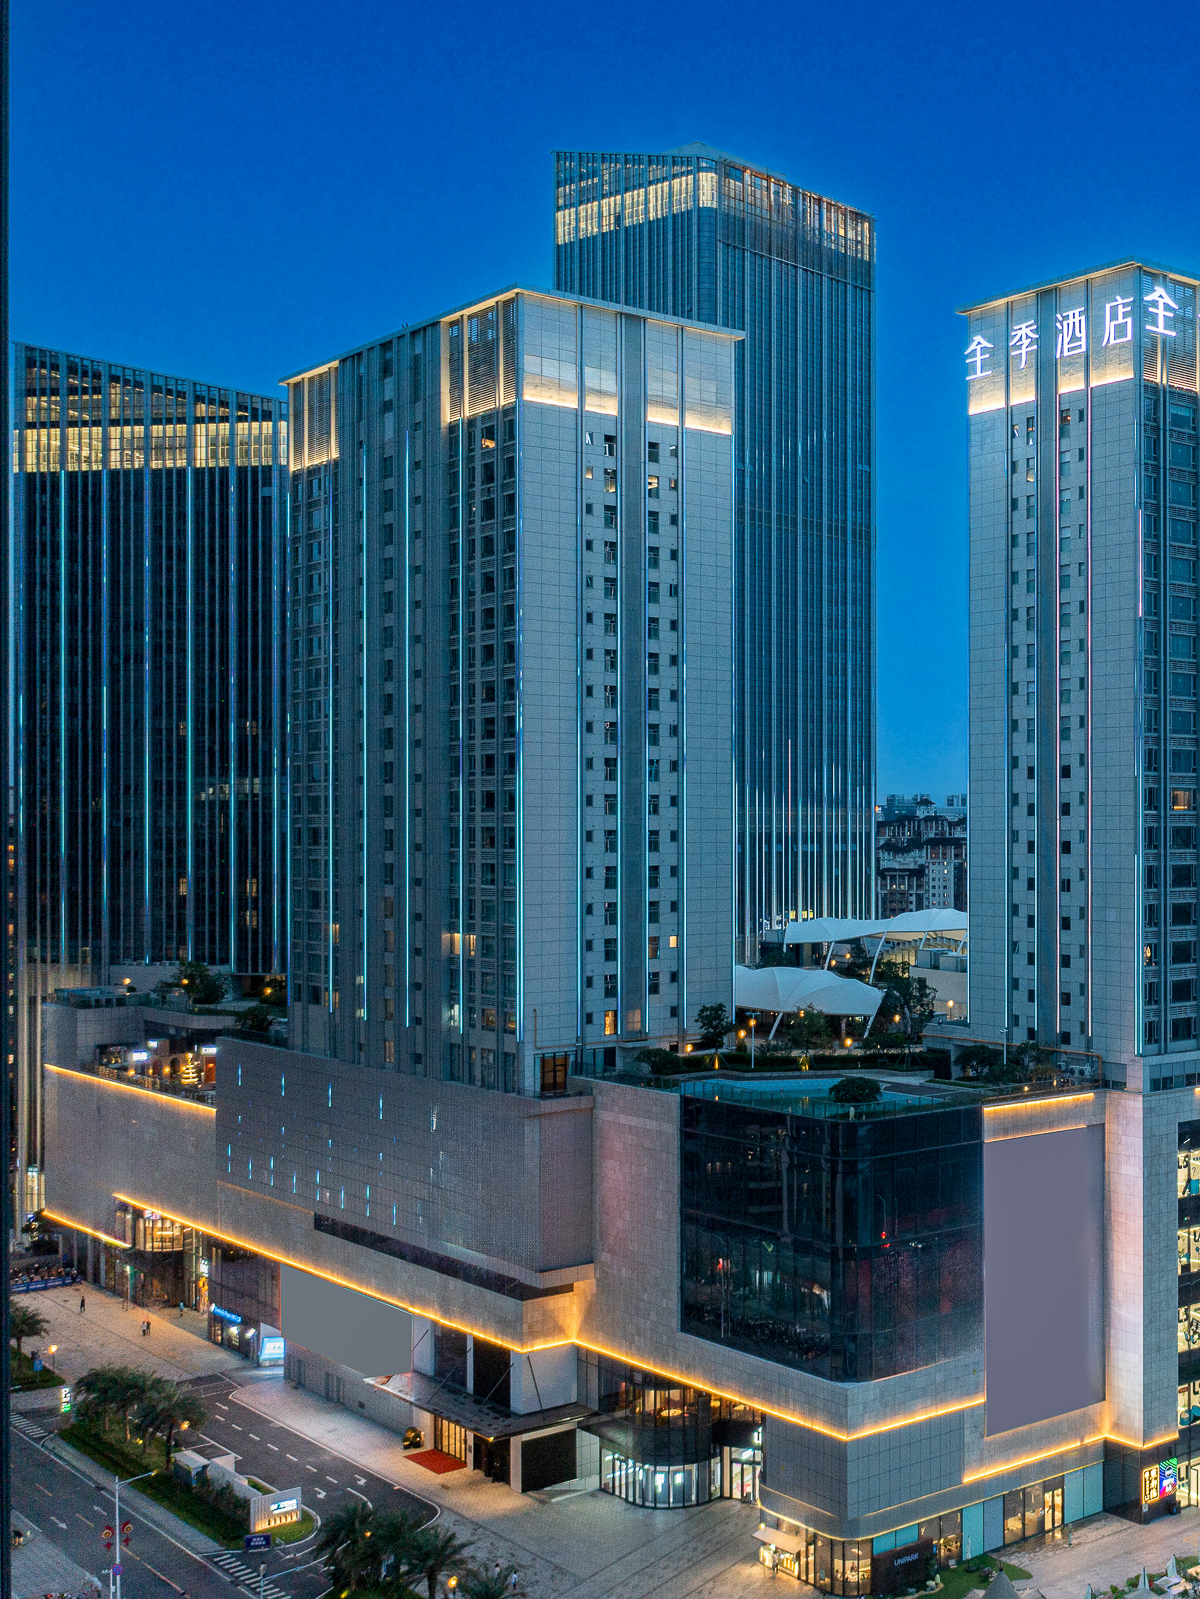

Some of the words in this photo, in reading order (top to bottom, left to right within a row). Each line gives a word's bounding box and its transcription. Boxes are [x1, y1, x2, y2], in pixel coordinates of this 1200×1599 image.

[964, 295, 1134, 381] 全季酒店
[893, 1552, 919, 1567] UNIPARK
